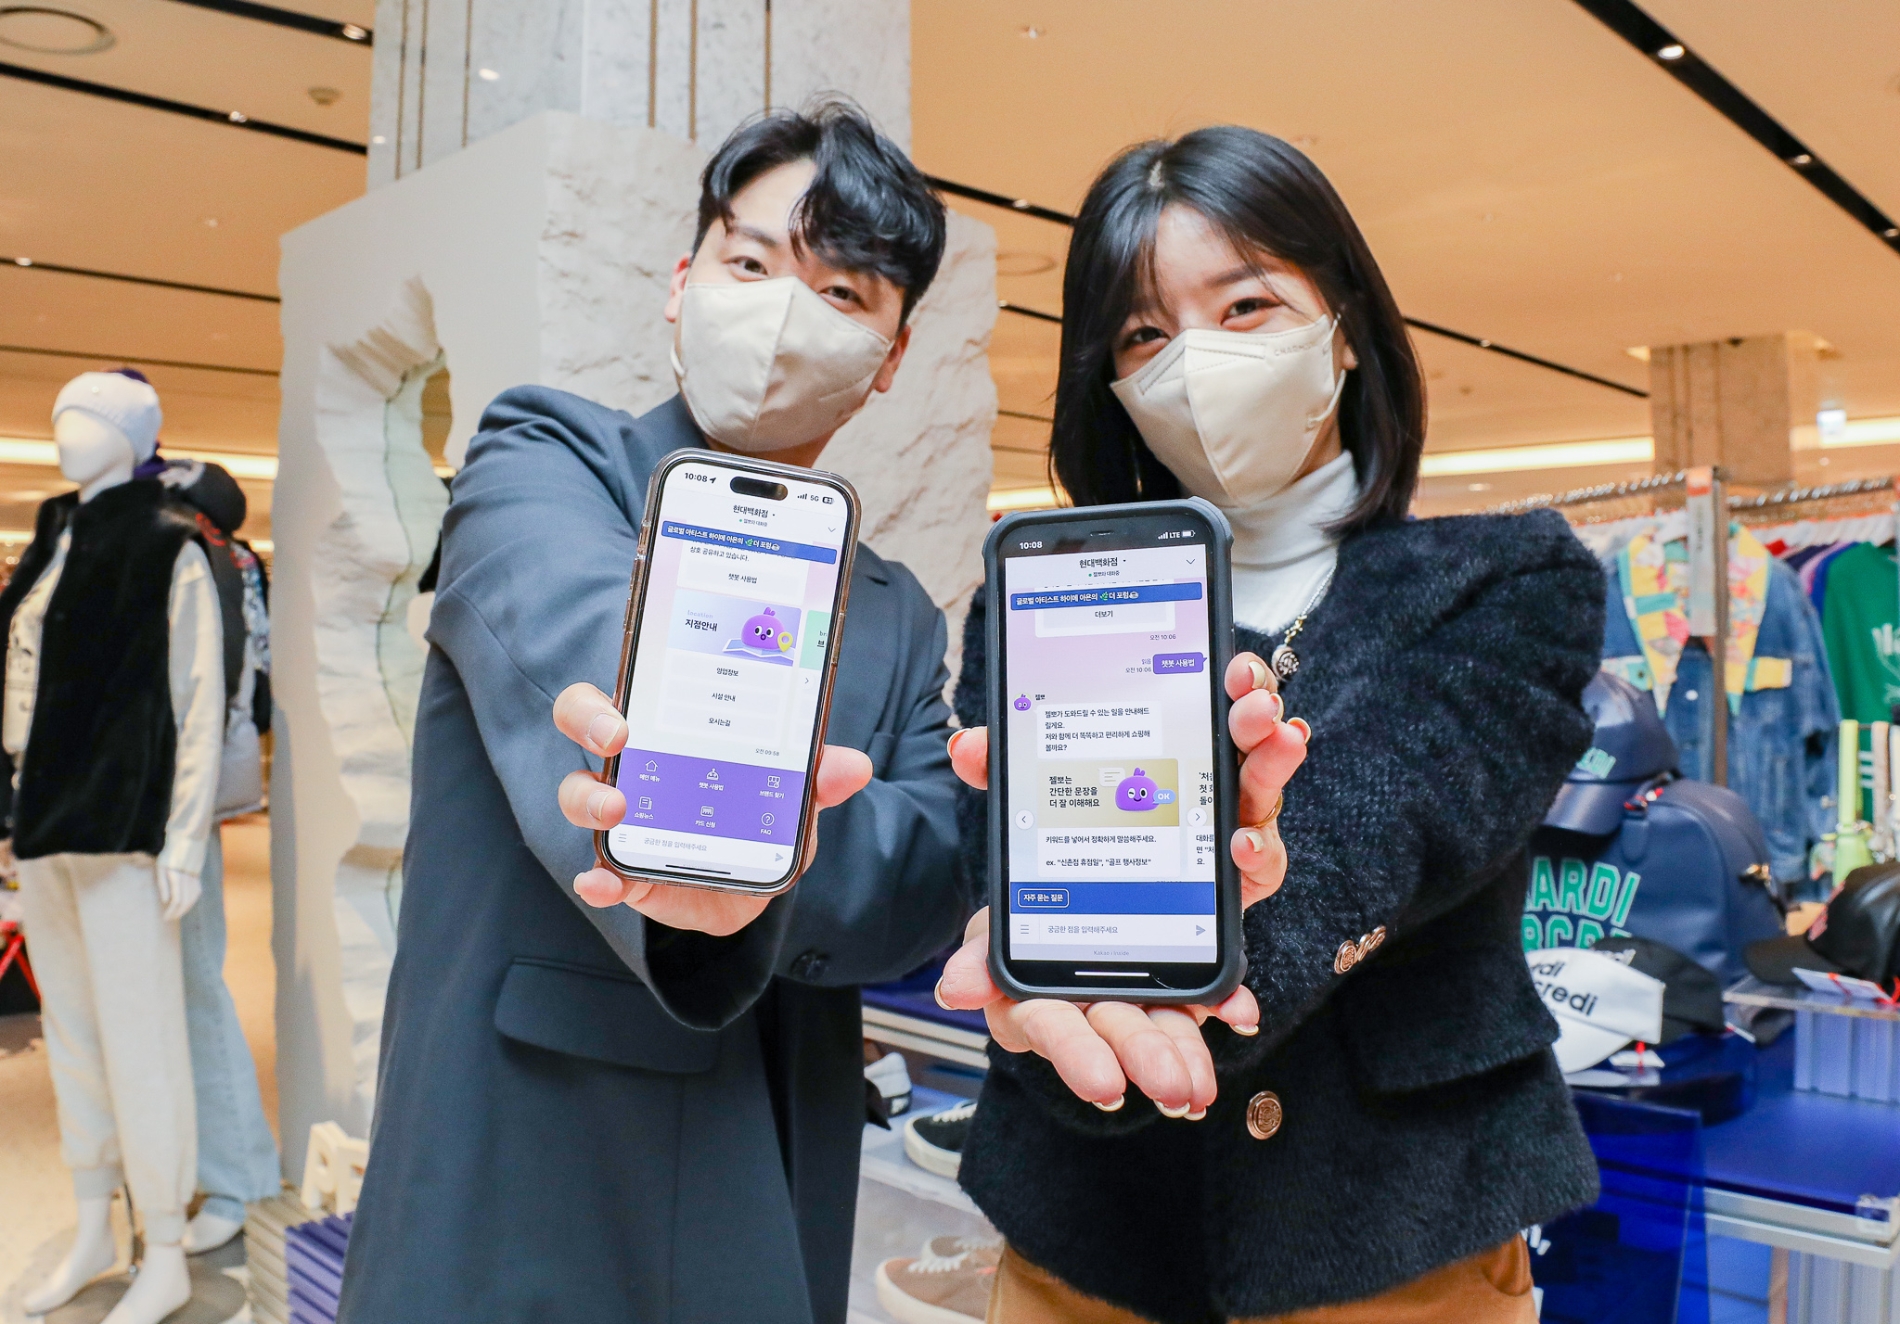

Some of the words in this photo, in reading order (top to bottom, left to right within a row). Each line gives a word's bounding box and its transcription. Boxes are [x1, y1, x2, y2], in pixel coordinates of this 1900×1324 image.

[684, 472, 708, 482] 10:08
[810, 494, 820, 502] 5G
[733, 504, 768, 518] 현대백화점
[667, 525, 685, 535] 글로벌
[686, 528, 709, 539] 아티스트
[1020, 541, 1042, 550] 10:08
[702, 547, 725, 558] 공유하고
[1080, 557, 1118, 568] 현대백화점
[728, 573, 740, 582] 챗봇
[740, 575, 758, 584] 사용법
[1016, 596, 1034, 606] 글로벌
[1034, 595, 1060, 604] 아티스트
[1108, 592, 1116, 600] 더
[1116, 591, 1129, 599] 포럼
[1094, 610, 1114, 618] 더보기
[685, 619, 718, 632] 지점안내
[1161, 659, 1175, 668] 챗봇
[1176, 658, 1195, 667] 사용법
[716, 667, 739, 677] 영업정보
[711, 692, 724, 701] 시설
[724, 694, 736, 702] 안내
[1064, 709, 1088, 718] 도와드릴
[1097, 708, 1110, 716] 있는
[1111, 708, 1124, 716] 일을
[1124, 707, 1150, 716] 안내해드
[708, 717, 731, 727] 오시는길
[1045, 722, 1065, 730] 릴게요.
[1045, 732, 1058, 740] 저와
[1058, 732, 1071, 740] 함께
[1072, 732, 1078, 740] 더
[1080, 732, 1104, 740] 똑똑하고
[1106, 730, 1130, 739] 편리하게
[1132, 730, 1150, 738] 쇼핑해
[1046, 744, 1068, 752] 볼까요?
[1050, 787, 1072, 796] 간단한
[1074, 786, 1098, 796] 문장을
[1199, 784, 1208, 794] 첫
[1157, 792, 1170, 800] OK
[1050, 799, 1058, 808] 더
[1059, 799, 1067, 808] 잘
[1068, 799, 1100, 808] 이해해요
[760, 828, 772, 836] FAQ
[1046, 836, 1070, 844] 키워드를
[1071, 836, 1090, 844] 넣어서
[1091, 836, 1116, 844] 정확하게
[1116, 835, 1156, 844] 말씀해주세요.
[1057, 858, 1079, 866] "신촌점
[1106, 858, 1122, 866] "골프
[1122, 858, 1152, 866] 행사정보"
[1526, 855, 1641, 928] ARDI
[1023, 893, 1036, 902] 자주
[1048, 926, 1066, 934] 궁금한
[1068, 926, 1080, 934] 점을
[1082, 926, 1118, 934] 입력해주세요
